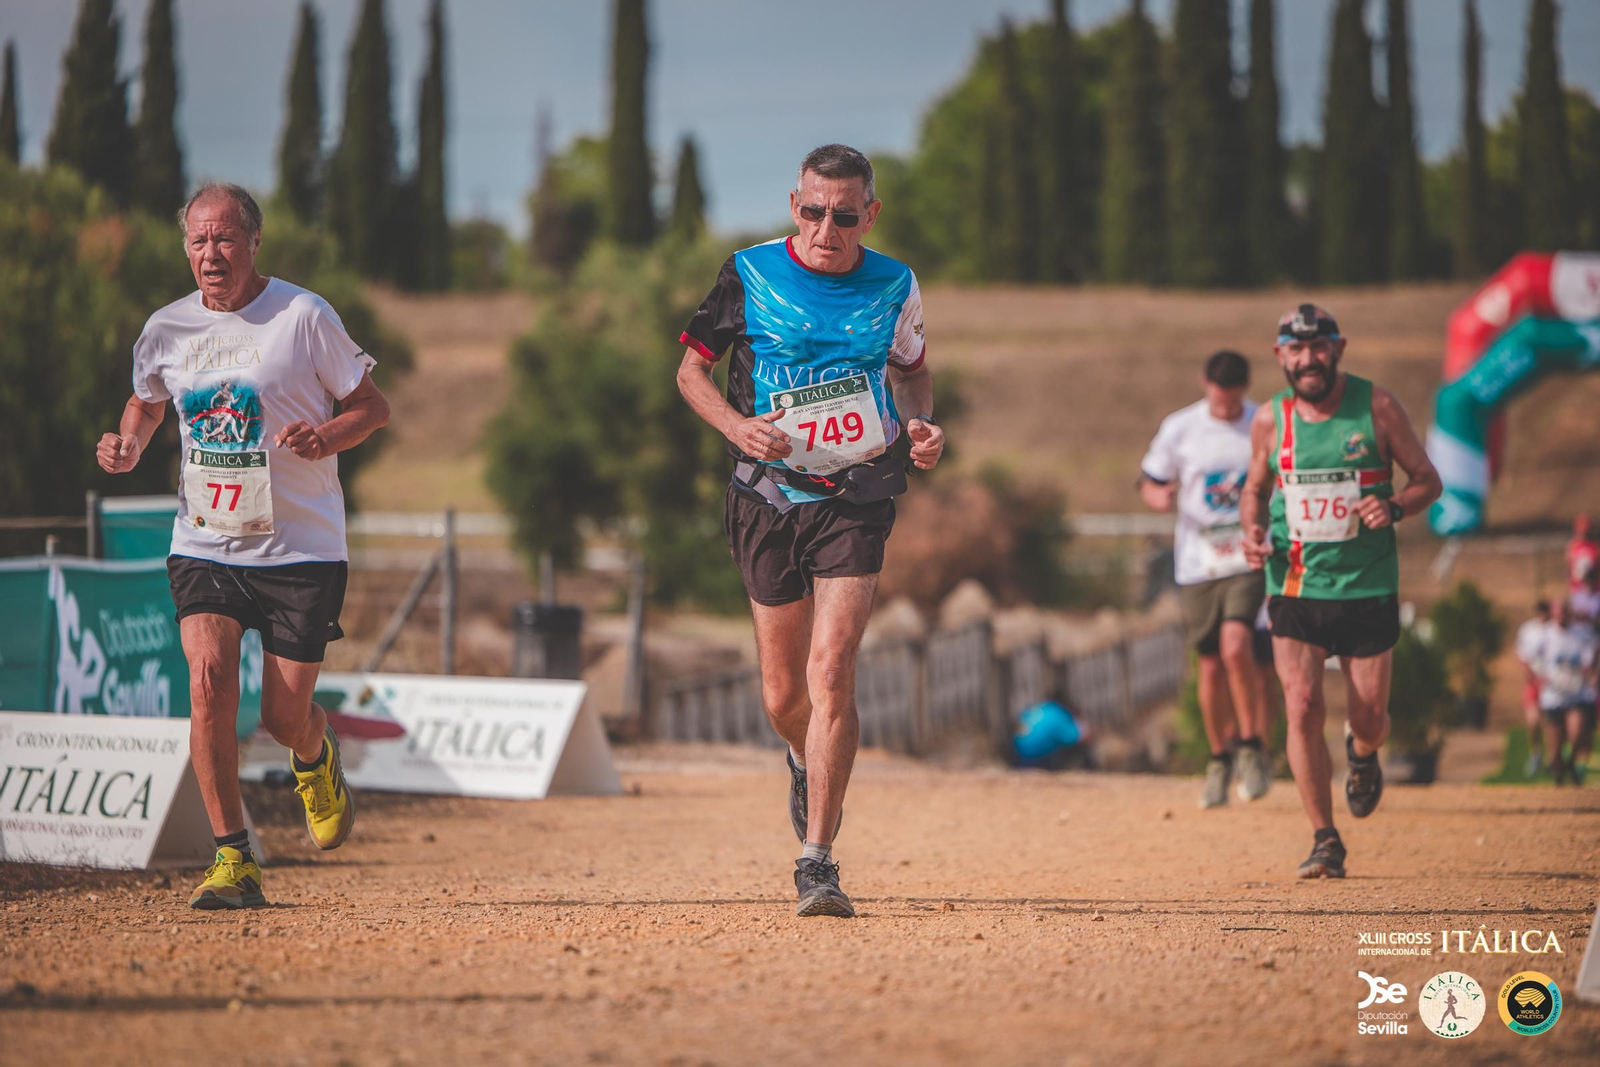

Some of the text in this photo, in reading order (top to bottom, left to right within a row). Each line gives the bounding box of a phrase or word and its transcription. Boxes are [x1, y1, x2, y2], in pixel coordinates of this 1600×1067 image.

[221, 334, 254, 345] CROSS
[798, 384, 847, 403] ITÁLICA
[797, 411, 865, 453] 749
[203, 452, 243, 466] ITÁLICA
[206, 482, 243, 512] 77
[1301, 495, 1348, 521] 176
[16, 731, 180, 755] CROSS INTERNACIONAL DE
[0, 752, 153, 820] ITÁLICA
